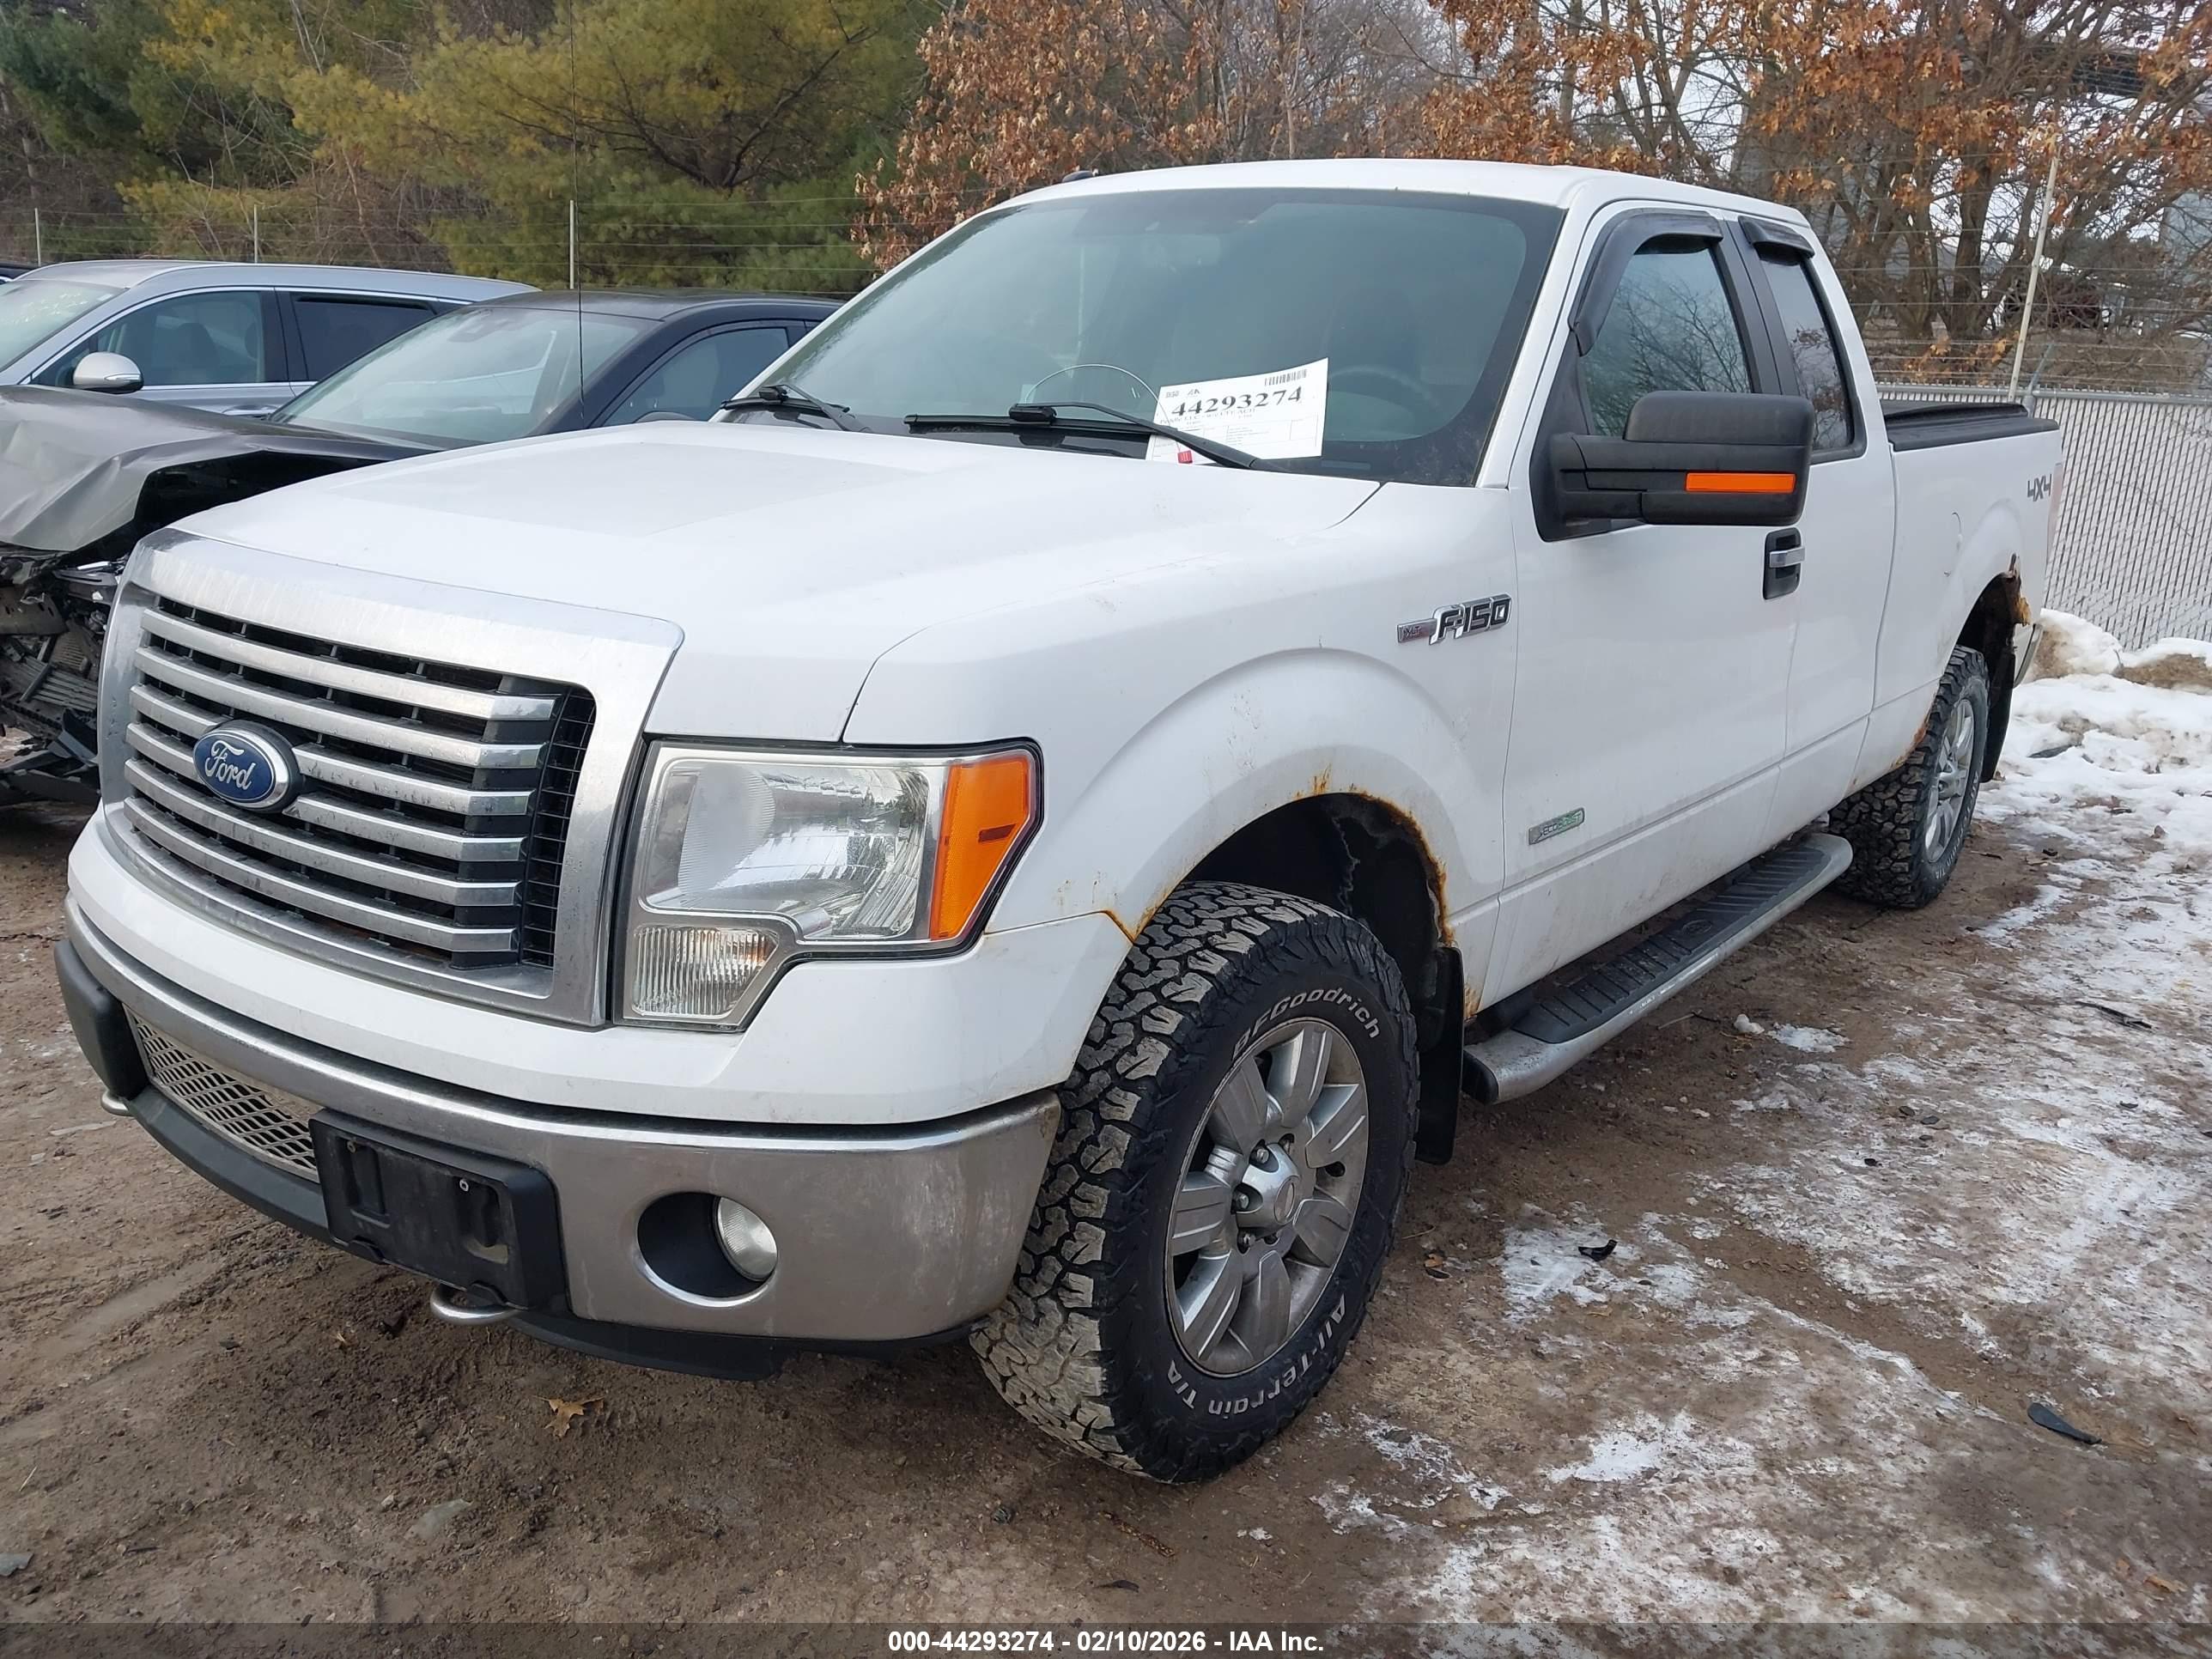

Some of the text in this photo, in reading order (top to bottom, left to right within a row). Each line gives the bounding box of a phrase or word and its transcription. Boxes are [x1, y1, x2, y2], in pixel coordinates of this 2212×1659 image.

[1170, 386, 1303, 417] 44293274
[1429, 592, 1512, 646] F-150
[204, 739, 257, 791] Ford
[1231, 987, 1381, 1061] BFGoodrich
[1167, 1359, 1197, 1409] T/A
